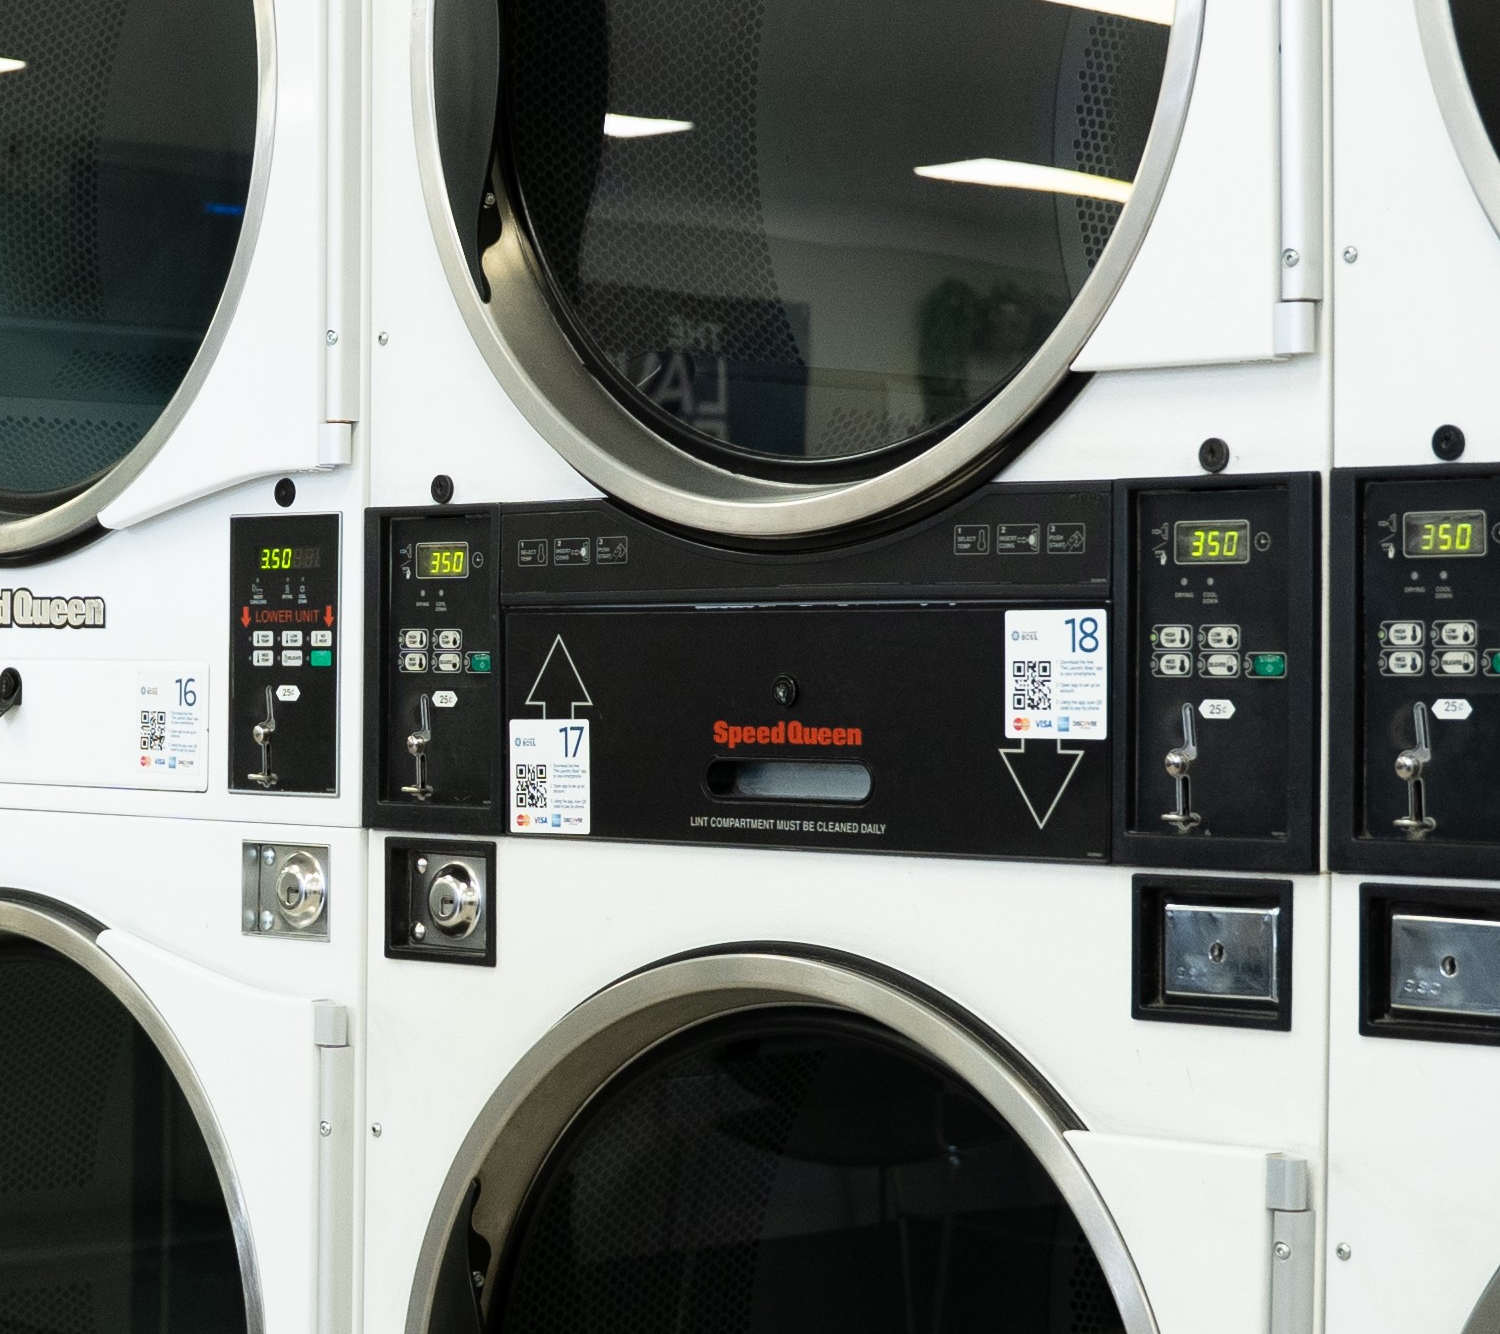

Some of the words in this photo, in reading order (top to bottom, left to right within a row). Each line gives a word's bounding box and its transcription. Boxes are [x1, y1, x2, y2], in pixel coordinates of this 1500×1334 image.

[13, 587, 106, 629] Queen
[255, 610, 293, 623] LOWER
[295, 610, 320, 623] UNIT
[1064, 617, 1099, 653] 18
[175, 678, 197, 707] 16
[559, 726, 584, 758] 17
[713, 720, 785, 748] Speed
[788, 720, 862, 746] Queen
[690, 816, 708, 827] LINT
[710, 817, 775, 830] COMPARTMENT
[776, 820, 801, 831] MUST
[803, 821, 815, 832] BE
[817, 822, 858, 833] CLEANED
[861, 823, 886, 834] DAILY
